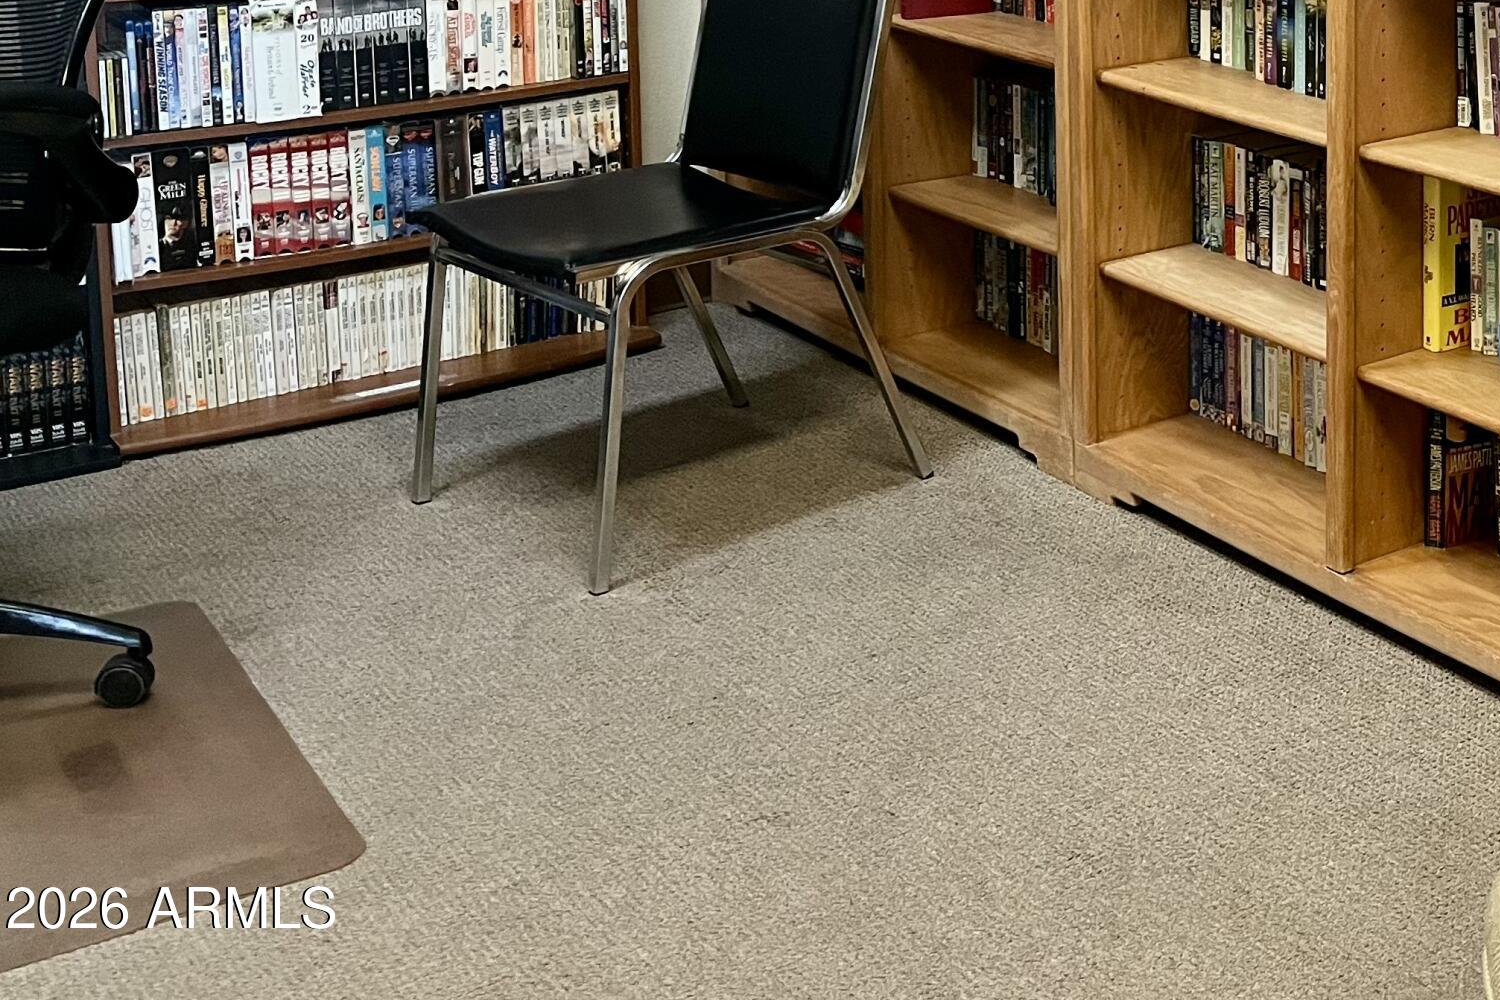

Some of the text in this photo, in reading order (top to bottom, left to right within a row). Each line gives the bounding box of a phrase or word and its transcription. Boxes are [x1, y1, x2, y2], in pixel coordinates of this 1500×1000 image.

[300, 34, 315, 42] 20
[320, 8, 422, 36] BAND BROTHERS
[156, 41, 169, 112] WINNING SEASON
[251, 155, 269, 189] ROCKY
[270, 152, 288, 187] ROCKY
[290, 151, 309, 186] ROCKY
[489, 138, 498, 185] WATERBOY
[158, 183, 187, 200] GREEN MILE
[198, 175, 206, 197] Happy
[140, 186, 154, 232] GHOST
[1428, 207, 1437, 242] BURN
